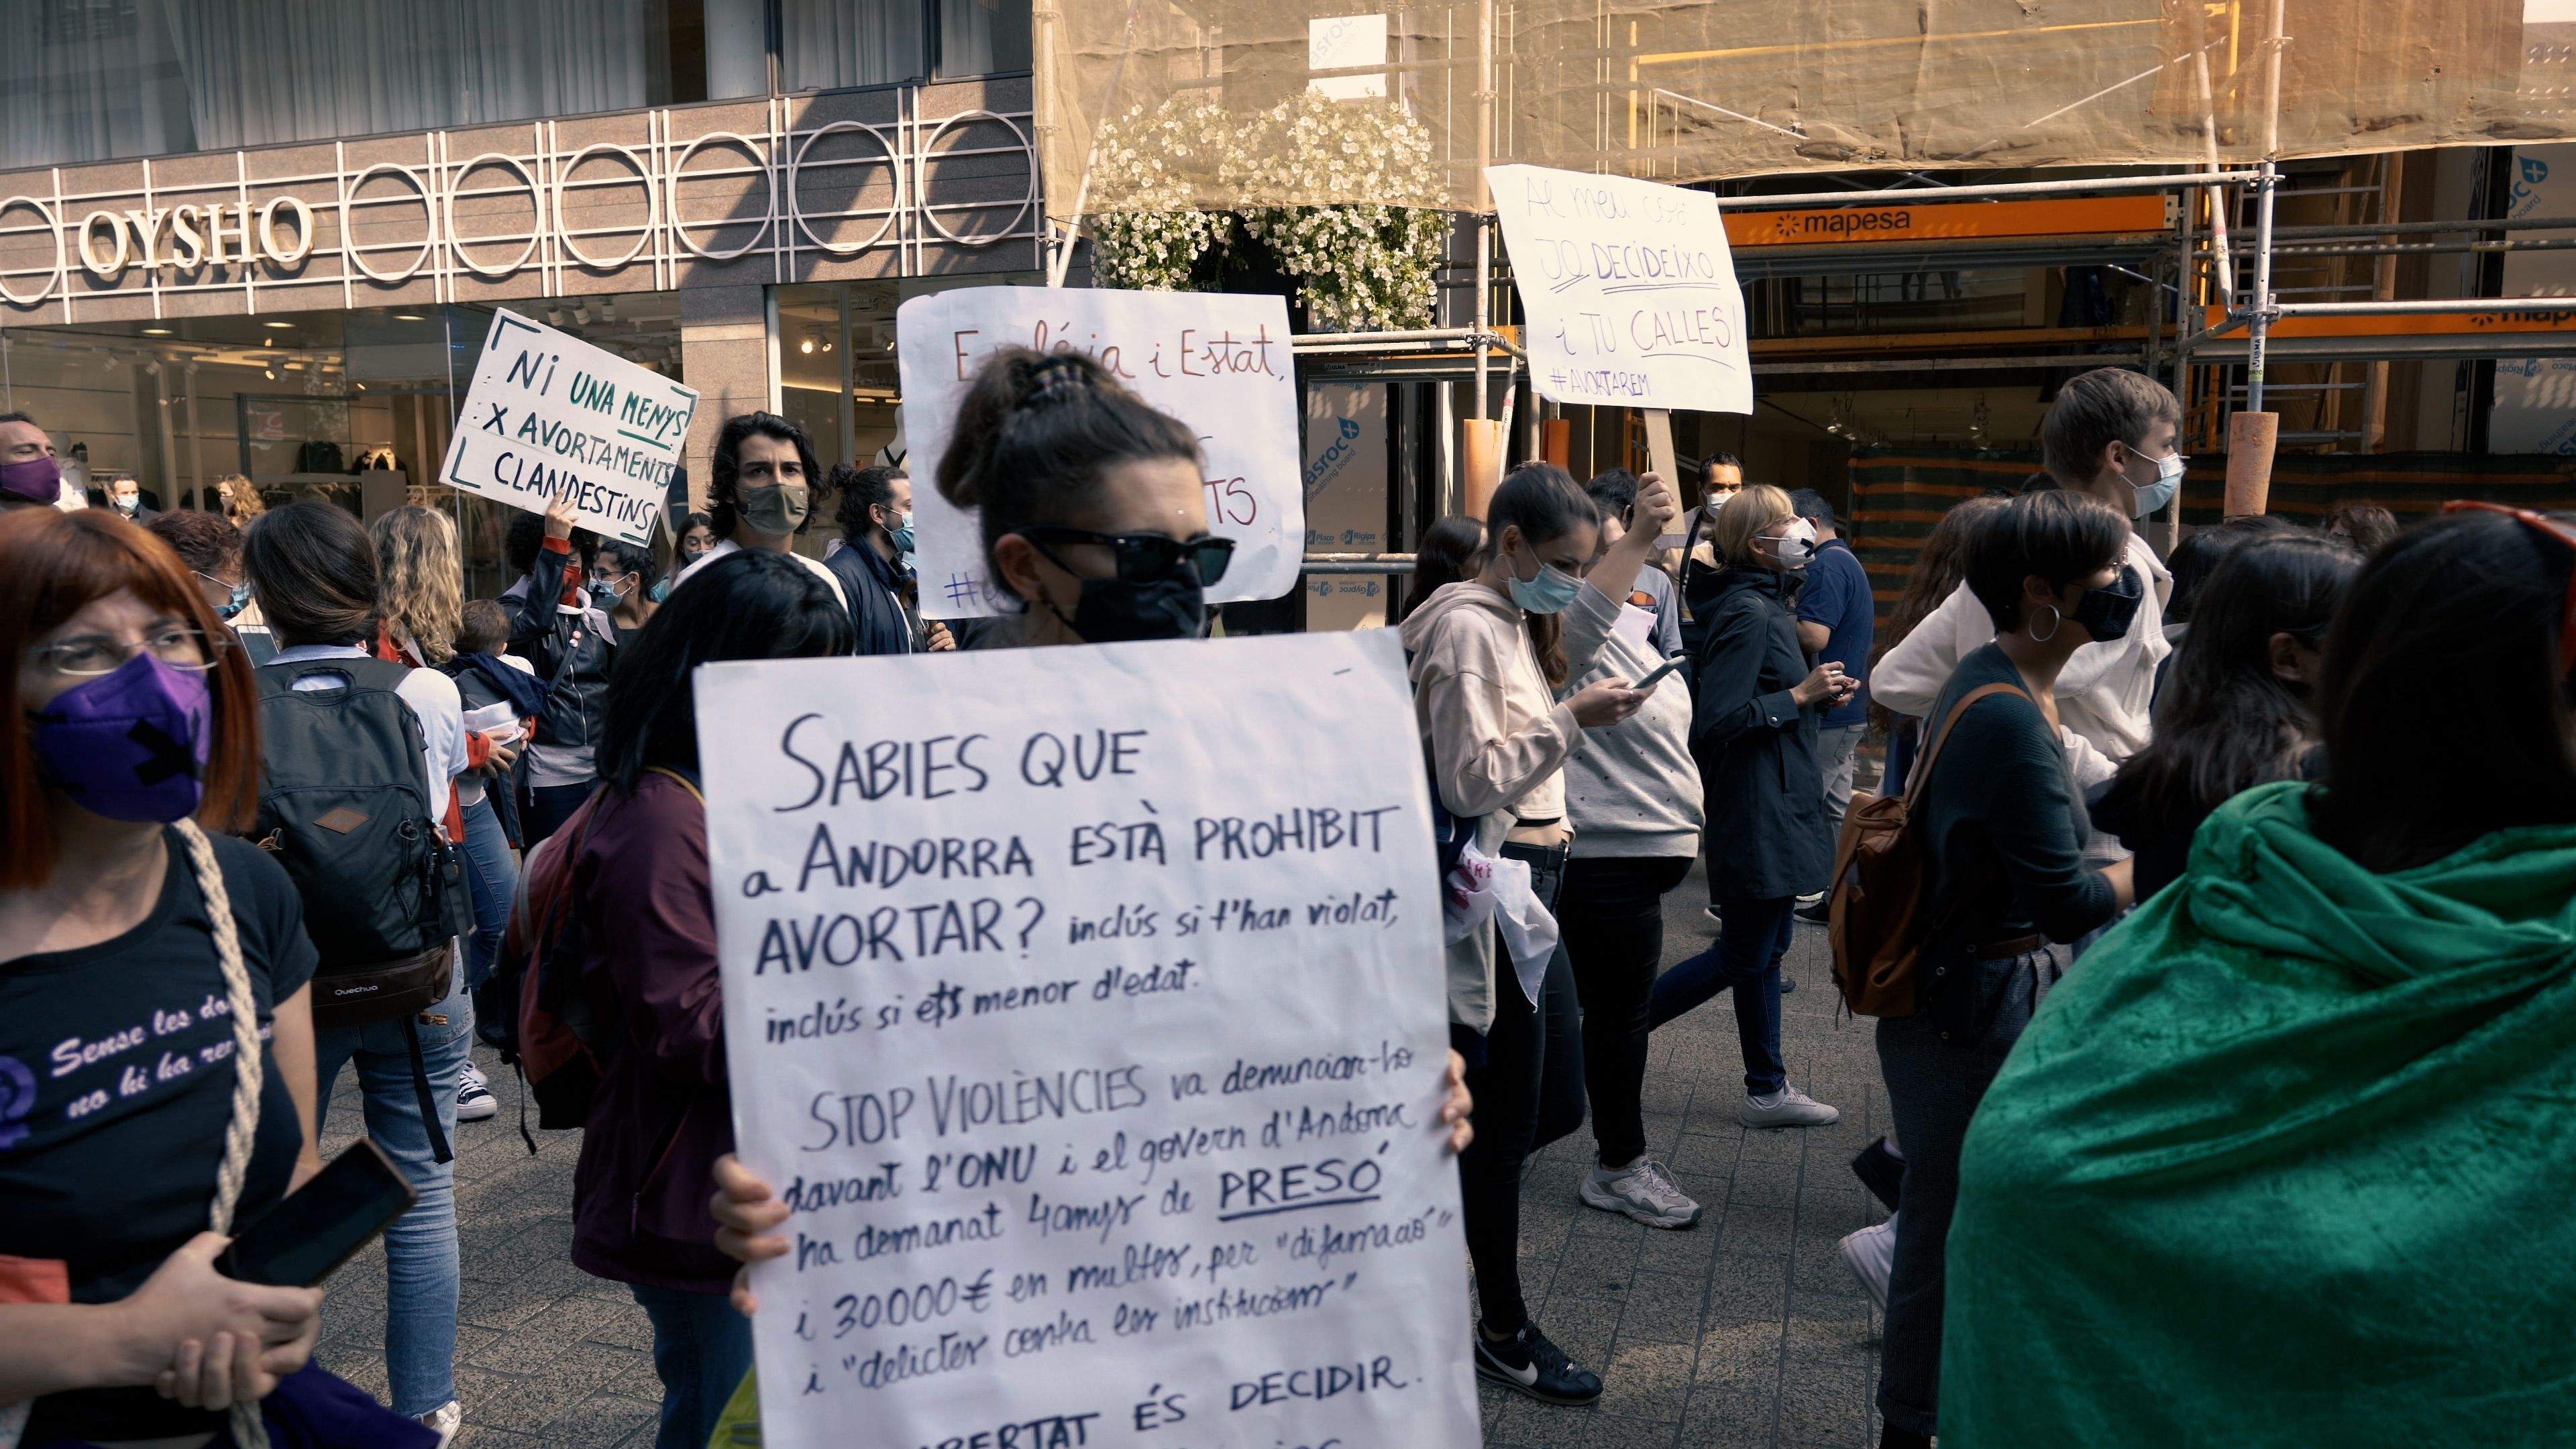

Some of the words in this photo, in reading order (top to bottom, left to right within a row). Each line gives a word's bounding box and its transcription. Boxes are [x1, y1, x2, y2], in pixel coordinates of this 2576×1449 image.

[78, 196, 315, 274] OYSHO
[1805, 211, 1911, 237] mapesa
[1148, 342, 1173, 378] i
[1579, 312, 1617, 356] TU
[570, 371, 616, 415] UNA
[620, 390, 688, 441] MENYS
[517, 412, 677, 488] AVORTAMENTS
[1353, 532, 1376, 543] Rigips
[1339, 584, 1366, 594] Gyproc
[773, 712, 989, 812] SABIES
[1020, 729, 1148, 788] QUE
[742, 870, 781, 898] a
[797, 822, 1034, 892] ANDORRA
[1071, 799, 1167, 866] ESTÀ
[1194, 805, 1401, 861] PROHIBIT
[1069, 904, 1159, 945] inclús
[1176, 905, 1205, 938] si
[1210, 898, 1291, 933] t'han
[335, 985, 378, 996] Quechua
[766, 998, 863, 1044] inclús
[875, 994, 904, 1031] si
[973, 979, 1080, 1016] menor
[52, 1026, 146, 1077] Sense
[153, 1010, 194, 1035] les
[68, 1089, 110, 1119] no
[119, 1065, 148, 1097] hi
[156, 1052, 193, 1081] ha
[800, 1087, 914, 1152] STOP
[927, 1064, 1147, 1138] VIOLÈNCIES
[1171, 1073, 1207, 1101] va
[783, 1161, 903, 1215] davant
[921, 1144, 1037, 1192] l'ONU
[1057, 1144, 1077, 1175] i
[1091, 1131, 1128, 1173] el
[1139, 1126, 1246, 1186] govern
[798, 1232, 842, 1272] ha
[855, 1201, 1005, 1261] demanat
[1161, 1179, 1195, 1216] de
[1219, 1140, 1390, 1210] PRESÓ
[794, 1300, 816, 1341] i
[1006, 1274, 1047, 1303] en
[1207, 1241, 1259, 1284] per
[804, 1363, 825, 1396] i
[1133, 1383, 1187, 1433] ÉS
